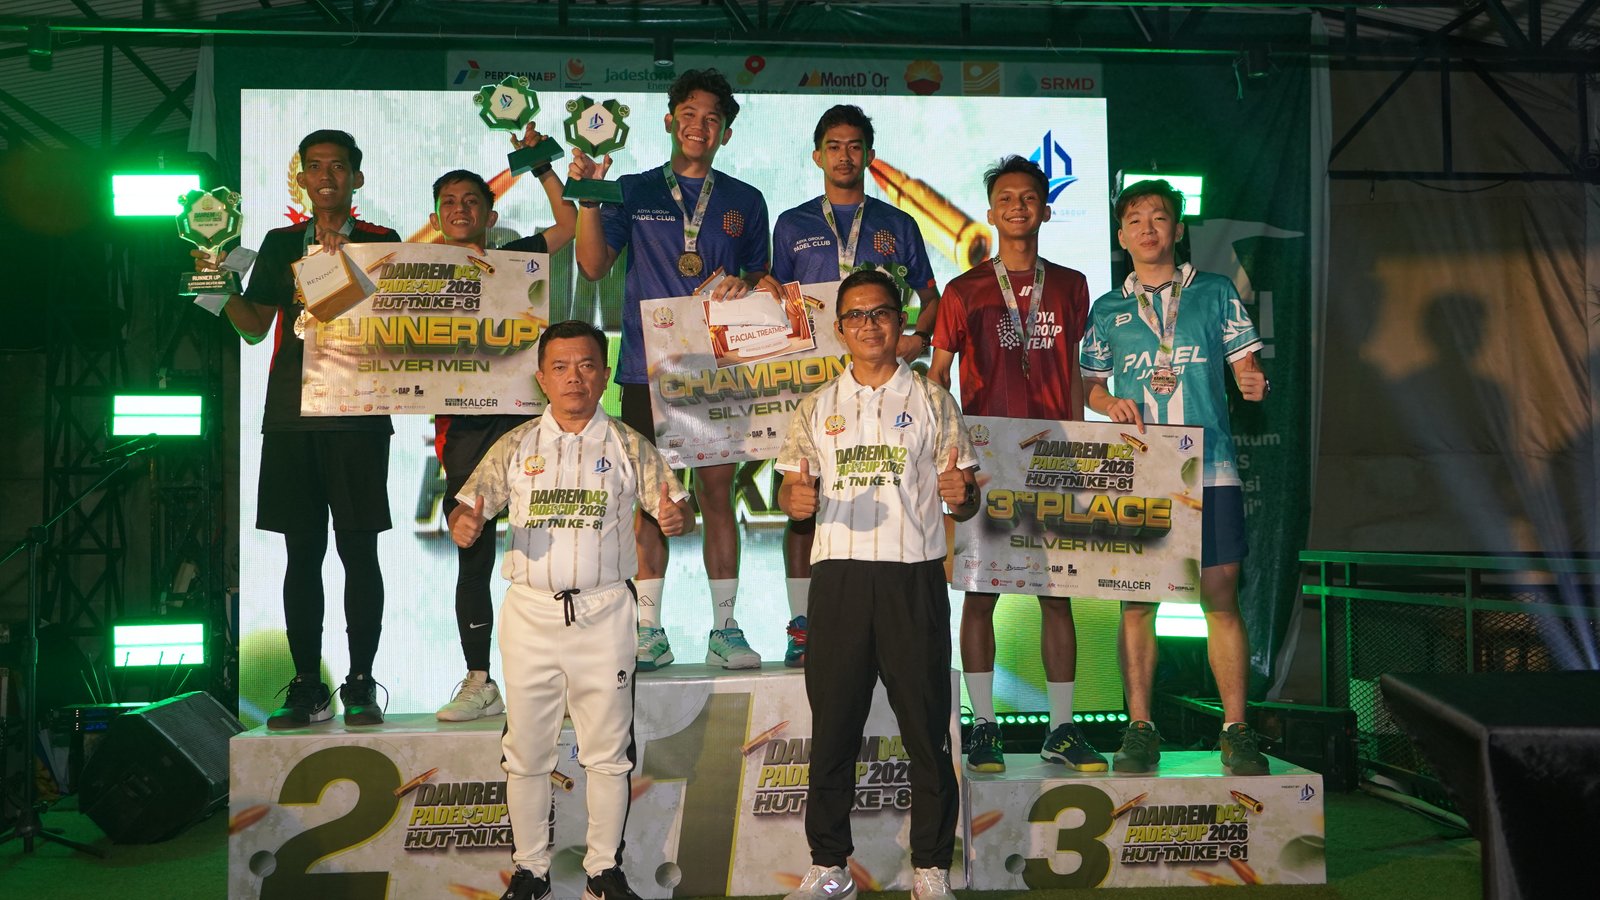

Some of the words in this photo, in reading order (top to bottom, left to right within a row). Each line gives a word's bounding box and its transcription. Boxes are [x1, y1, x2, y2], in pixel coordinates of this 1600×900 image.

[604, 68, 676, 83] Jadestone
[1040, 76, 1095, 91] SRMD
[793, 243, 812, 253] PADEL
[376, 279, 417, 294] PADEL
[420, 279, 447, 294] CUP
[447, 280, 482, 295] 2026
[371, 294, 404, 312] HUT
[405, 296, 431, 311] TNI
[431, 296, 455, 311] KE
[464, 297, 481, 311] 81
[1025, 311, 1055, 324] DYA
[314, 315, 479, 352] RUNNER
[484, 317, 541, 352] UP
[729, 331, 757, 344] FACIAL
[756, 326, 787, 338] TREATMEN
[1031, 324, 1063, 337] ROUP
[357, 358, 434, 373] SILVER
[437, 359, 490, 373] MEN
[1136, 364, 1185, 380] JABI
[659, 354, 852, 402] CHAMPION
[460, 398, 498, 407] KALCER
[708, 400, 783, 421] SILVER
[858, 460, 880, 474] CUP
[1029, 456, 1070, 472] PADEL
[1074, 457, 1100, 473] CUP
[1099, 459, 1135, 475] 2026
[848, 476, 867, 487] TNI
[869, 476, 886, 487] KE
[1025, 472, 1058, 488] HUT
[1059, 474, 1085, 488] TNI
[1085, 475, 1108, 489] KE
[1116, 476, 1134, 491] 81
[557, 503, 579, 516] CUP
[579, 504, 606, 518] 2026
[1036, 491, 1172, 532] PLACE
[524, 519, 547, 529] HUT
[547, 518, 566, 528] TNI
[567, 518, 585, 529] KE
[592, 520, 603, 530] 81
[1010, 535, 1087, 552] SILVER
[1091, 539, 1144, 555] MEN
[1051, 565, 1063, 573] DAP
[1113, 580, 1151, 590] KALCER
[641, 692, 753, 898] 1
[753, 790, 807, 817] HUT
[258, 745, 404, 900] 2
[408, 806, 467, 827] PADEL
[472, 805, 511, 826] CUP
[403, 828, 453, 849] HUT
[454, 828, 487, 847] TNI
[1024, 783, 1115, 889] 3
[1124, 824, 1173, 844] PADEL
[1177, 824, 1208, 843] CUP
[1208, 824, 1249, 842] 2026
[1121, 846, 1162, 864] HUT
[1163, 846, 1193, 863] TNI
[1193, 845, 1219, 862] KE
[1228, 845, 1249, 861] 81
